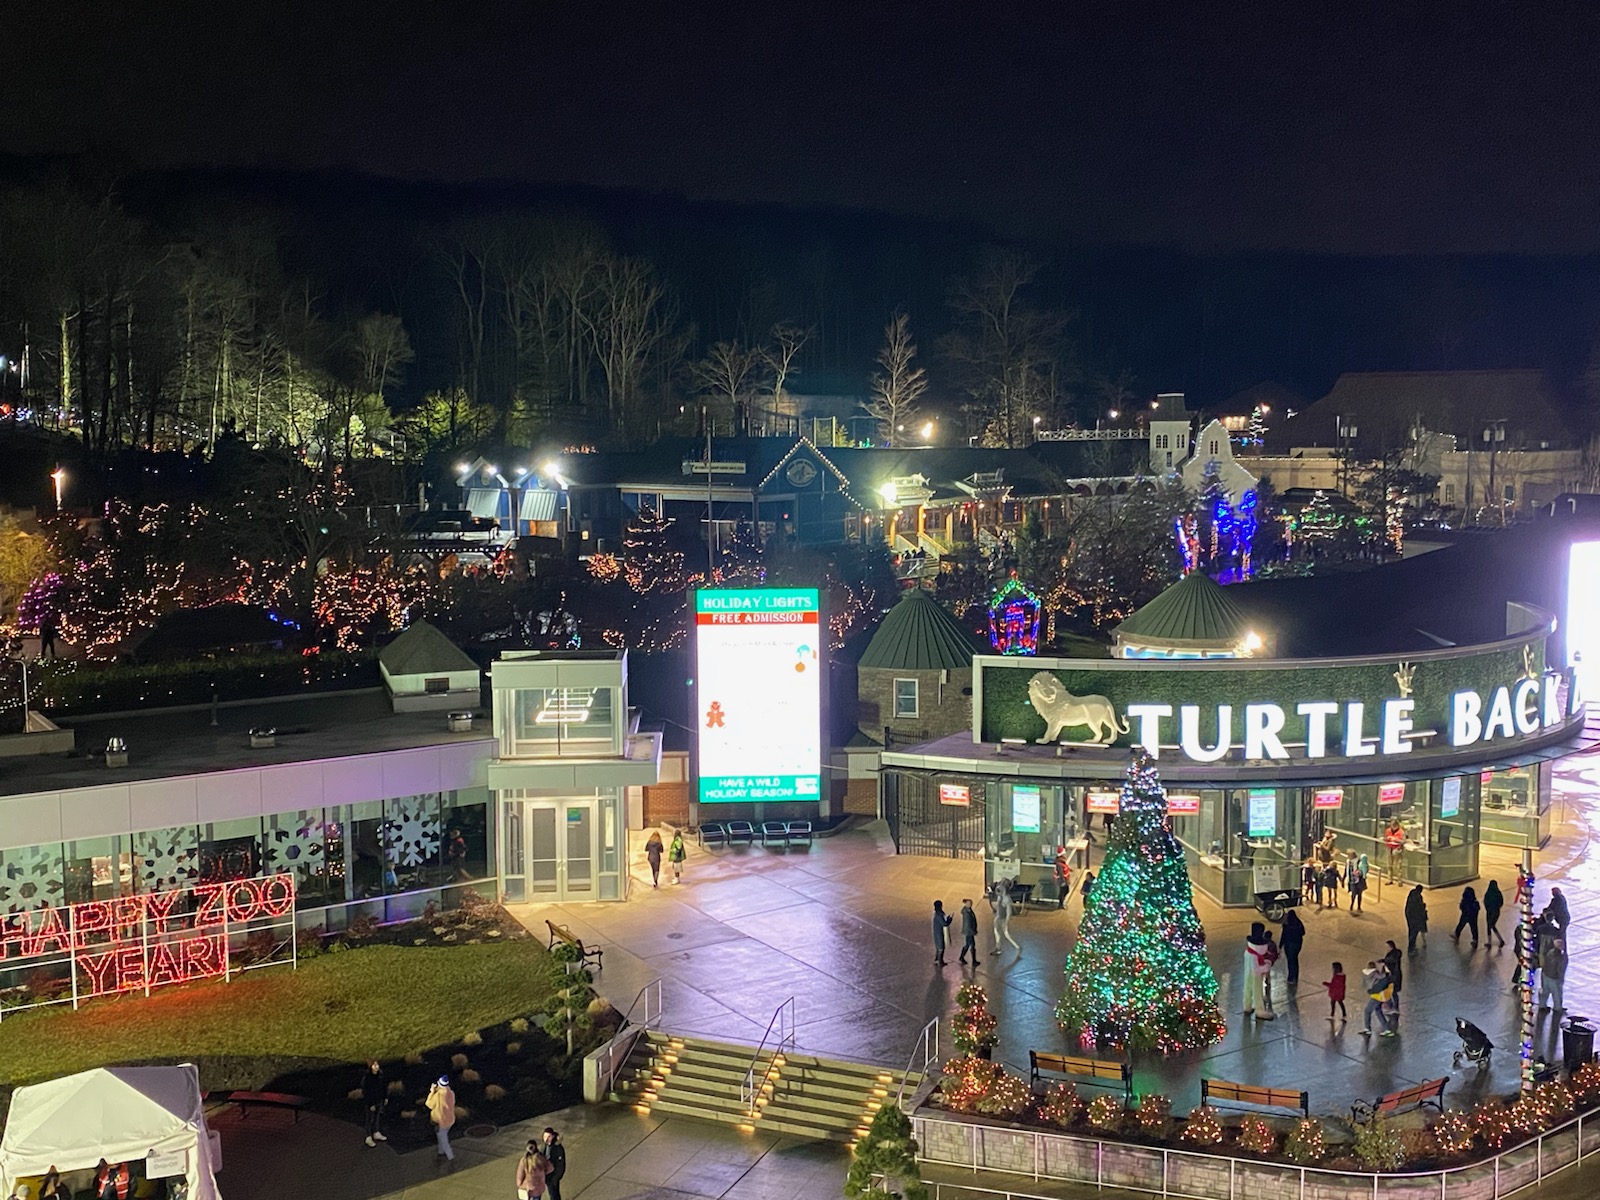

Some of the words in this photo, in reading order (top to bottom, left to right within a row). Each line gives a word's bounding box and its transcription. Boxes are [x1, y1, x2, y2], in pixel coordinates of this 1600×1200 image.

[703, 596, 762, 609] HOLIDAY
[765, 597, 812, 608] LIGHTS
[712, 613, 741, 624] FREE
[744, 612, 804, 623] ADMISSION
[1126, 698, 1415, 762] TURTLE
[1452, 674, 1563, 747] BACK
[719, 778, 745, 788] HAVE
[746, 778, 754, 787] A
[755, 777, 781, 787] WILD
[705, 789, 748, 799] HOLIDAY
[0, 889, 180, 960] HAPPY
[193, 873, 295, 930] ZOO
